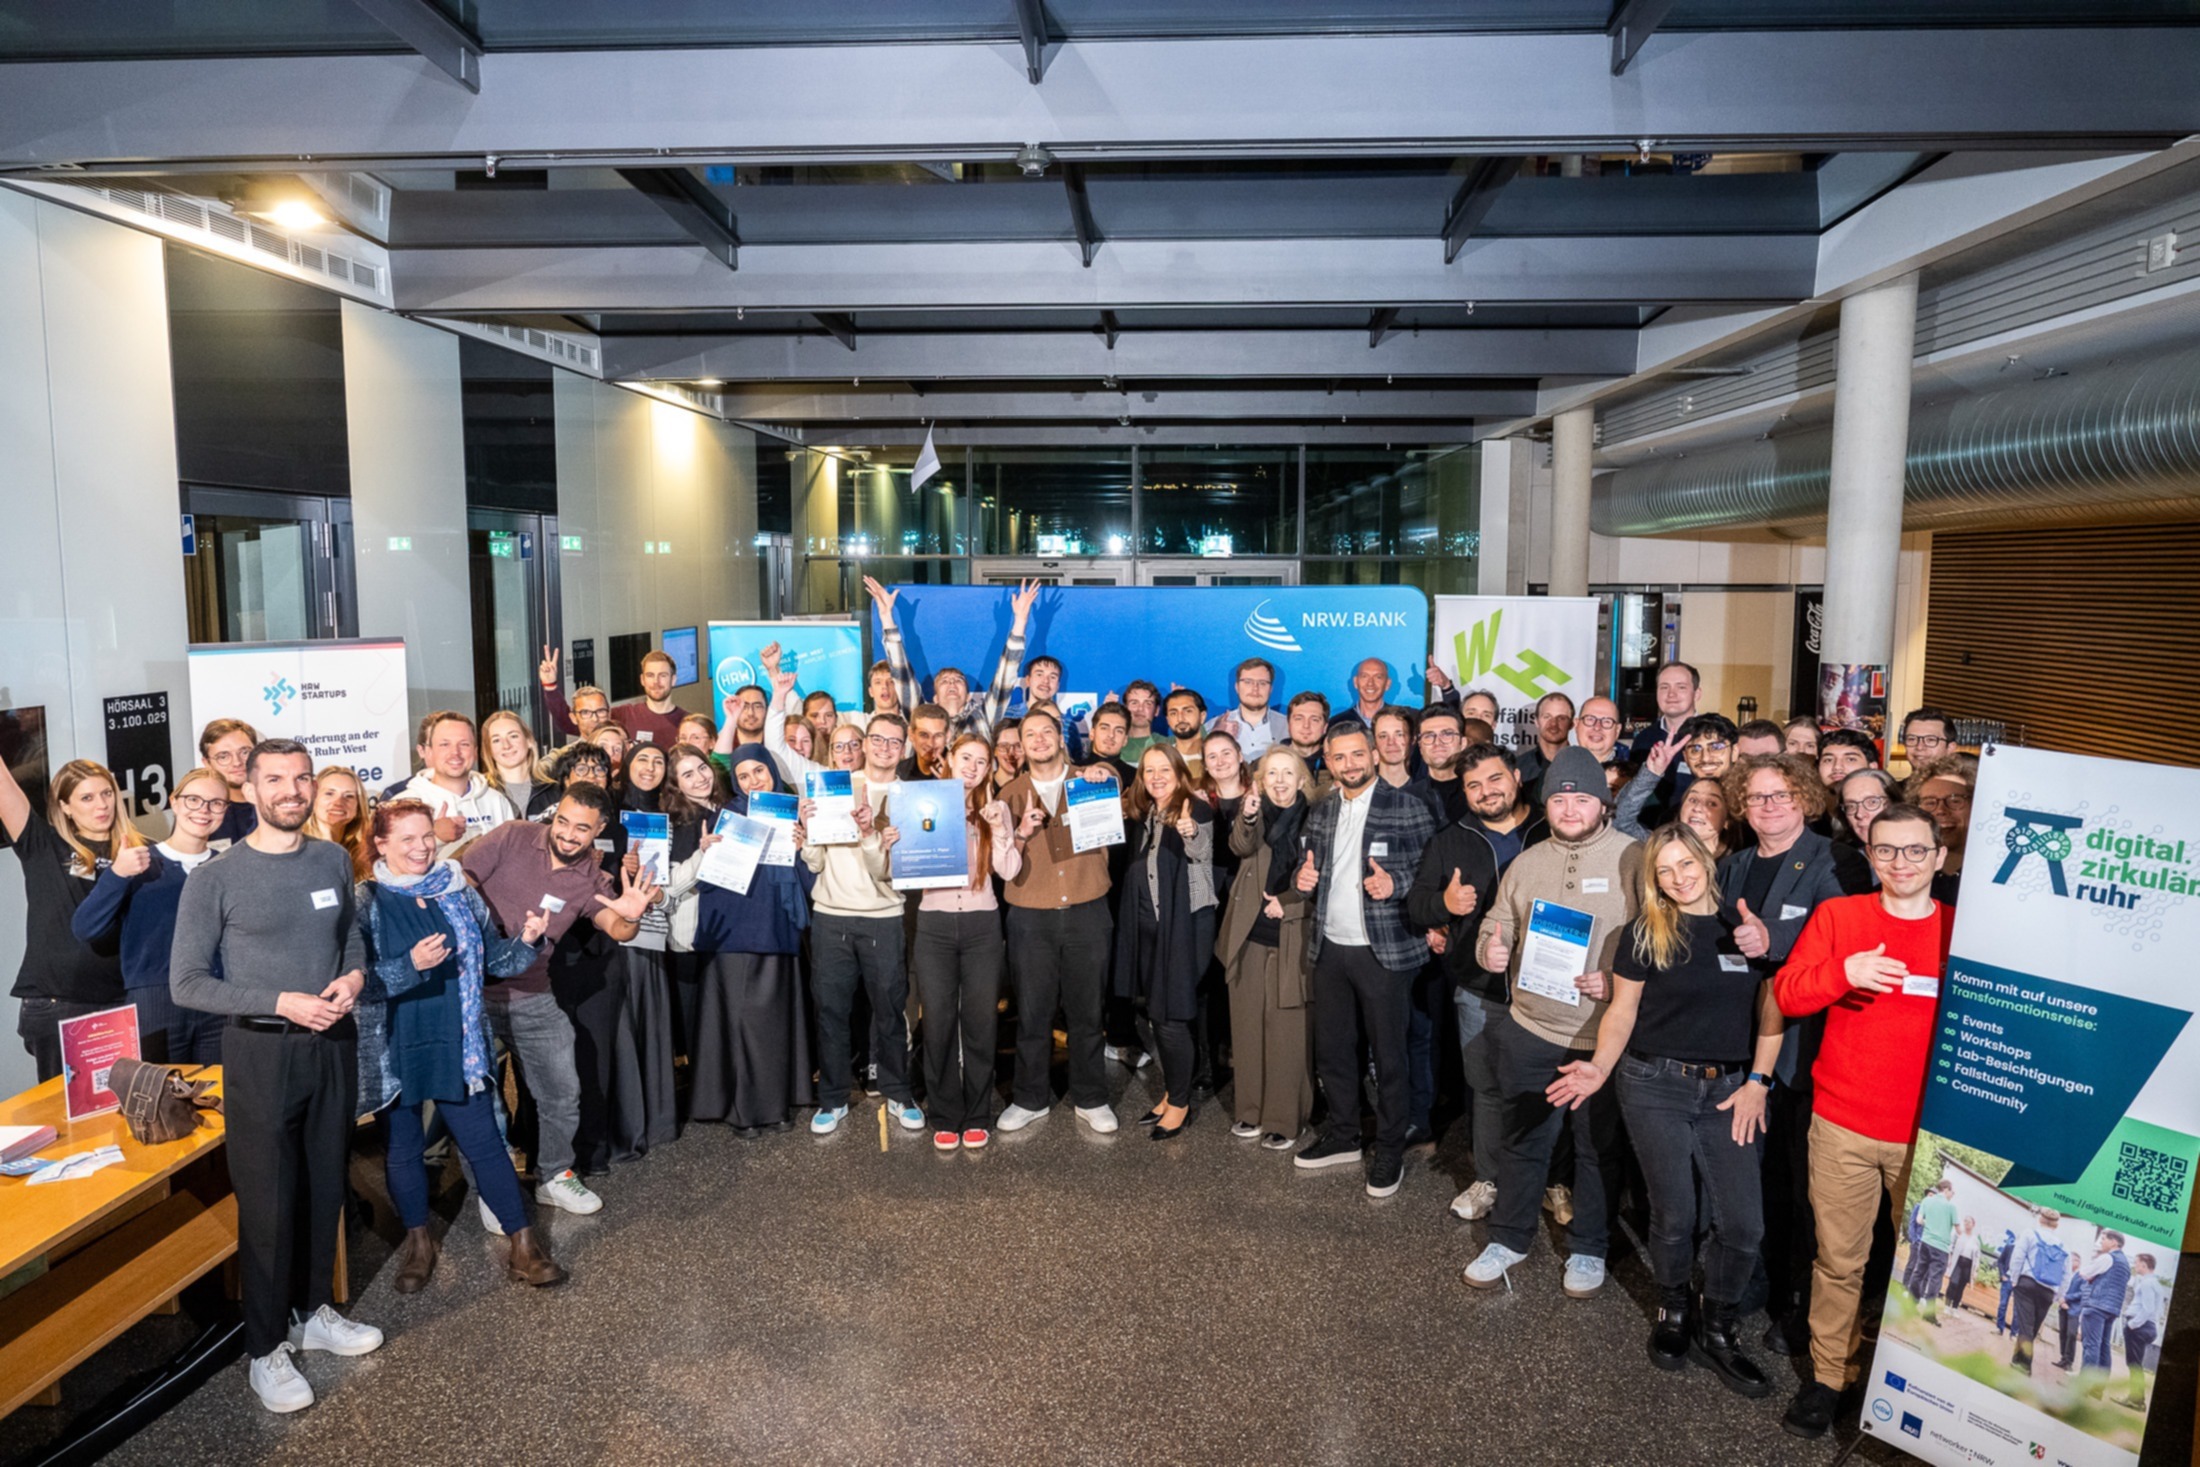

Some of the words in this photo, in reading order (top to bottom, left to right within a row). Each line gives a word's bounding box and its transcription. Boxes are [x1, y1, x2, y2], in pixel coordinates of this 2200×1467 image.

[1302, 611, 1408, 628] NRW.BANK
[721, 668, 750, 687] HRW
[107, 698, 154, 714] HÖRSAAL
[159, 696, 166, 708] 3
[301, 689, 347, 700] STARTUPS
[108, 711, 167, 730] 3.100.029
[1500, 707, 1536, 725] fälis
[294, 732, 347, 744] förderung
[348, 732, 361, 740] an
[362, 730, 380, 739] der
[315, 746, 341, 757] Ruhr
[343, 744, 367, 754] West
[2086, 827, 2191, 865] digital.
[2076, 883, 2141, 910] ruhr
[1953, 970, 1993, 990] Komm
[1996, 983, 2019, 996] mit
[2020, 988, 2045, 1003] auf
[2047, 995, 2098, 1015] unsere
[1951, 985, 2098, 1031] Transformationsreise:
[1962, 1014, 2004, 1035] Events
[1960, 1030, 2032, 1060] Workshops
[1954, 1062, 2024, 1093] Fallstudien
[1957, 1047, 2094, 1096] Lab-Besichtigungen
[1951, 1079, 2028, 1114] Community
